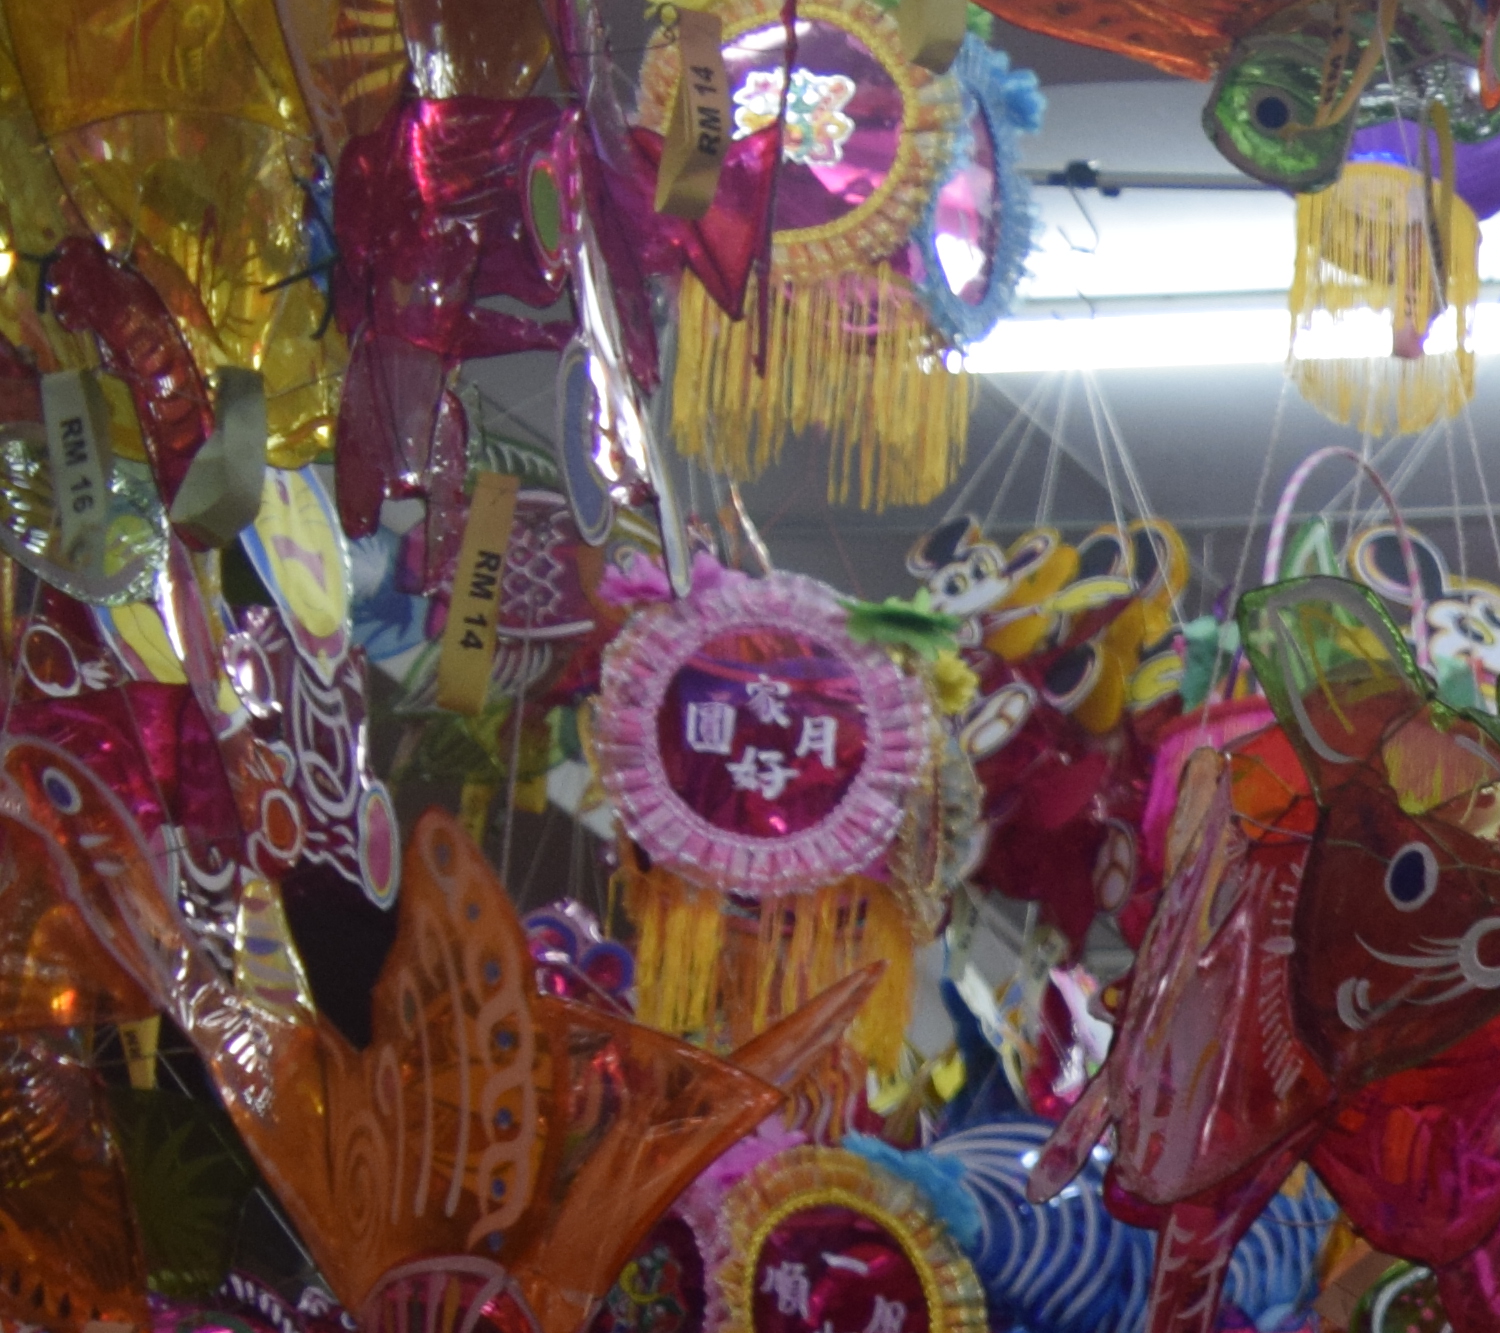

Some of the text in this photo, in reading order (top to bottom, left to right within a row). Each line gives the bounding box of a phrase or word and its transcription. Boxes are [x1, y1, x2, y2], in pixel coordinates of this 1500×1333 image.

[694, 65, 722, 156] RM 14
[63, 417, 94, 513] RM 16
[461, 549, 503, 653] RM 14
